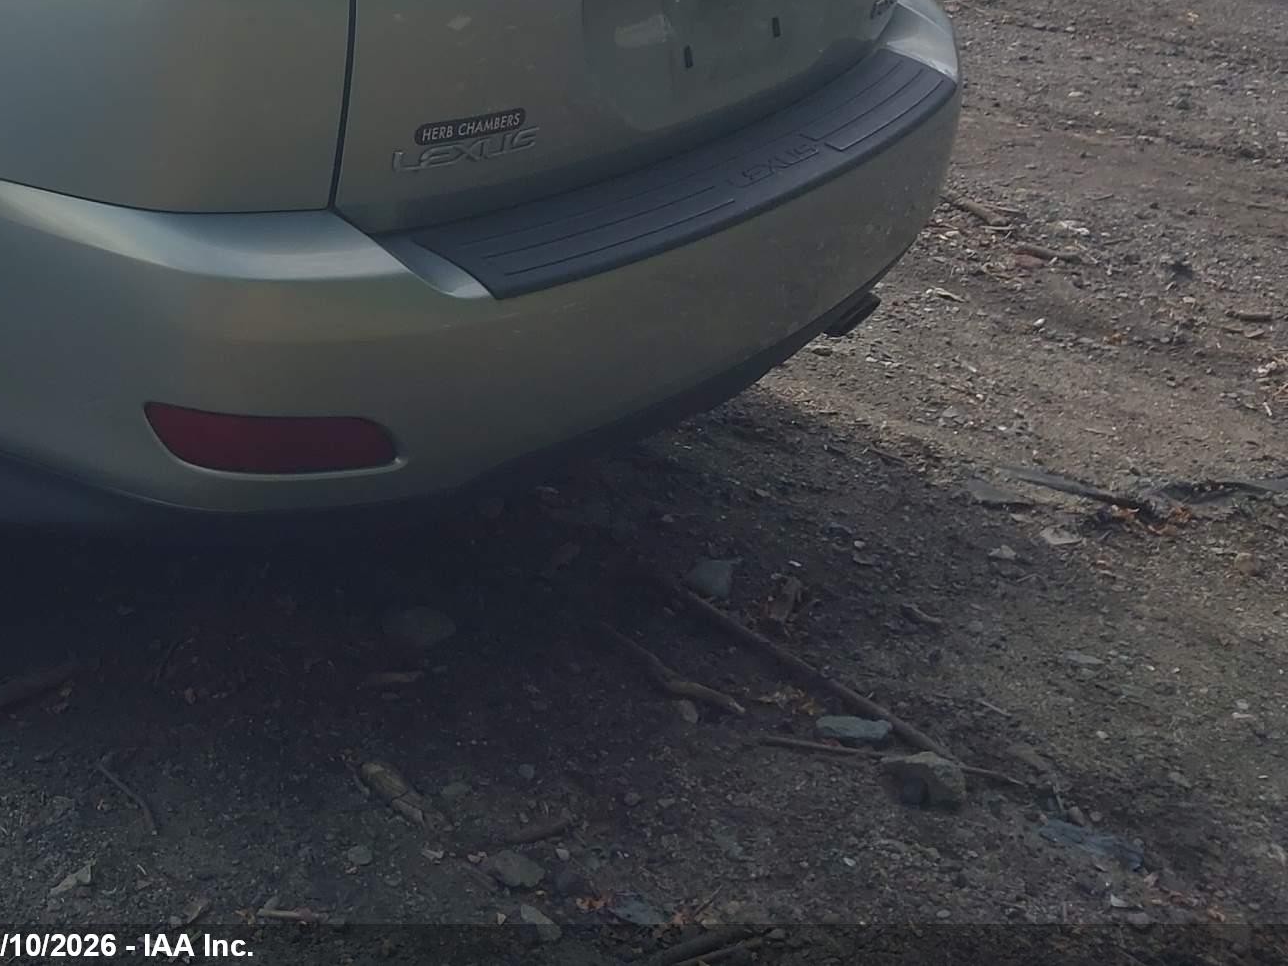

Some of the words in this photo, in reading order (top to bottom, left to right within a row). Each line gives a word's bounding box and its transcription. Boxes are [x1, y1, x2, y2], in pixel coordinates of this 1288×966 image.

[421, 126, 454, 142] HERB
[457, 113, 522, 136] CHAMBERS
[392, 127, 540, 172] LEXUS
